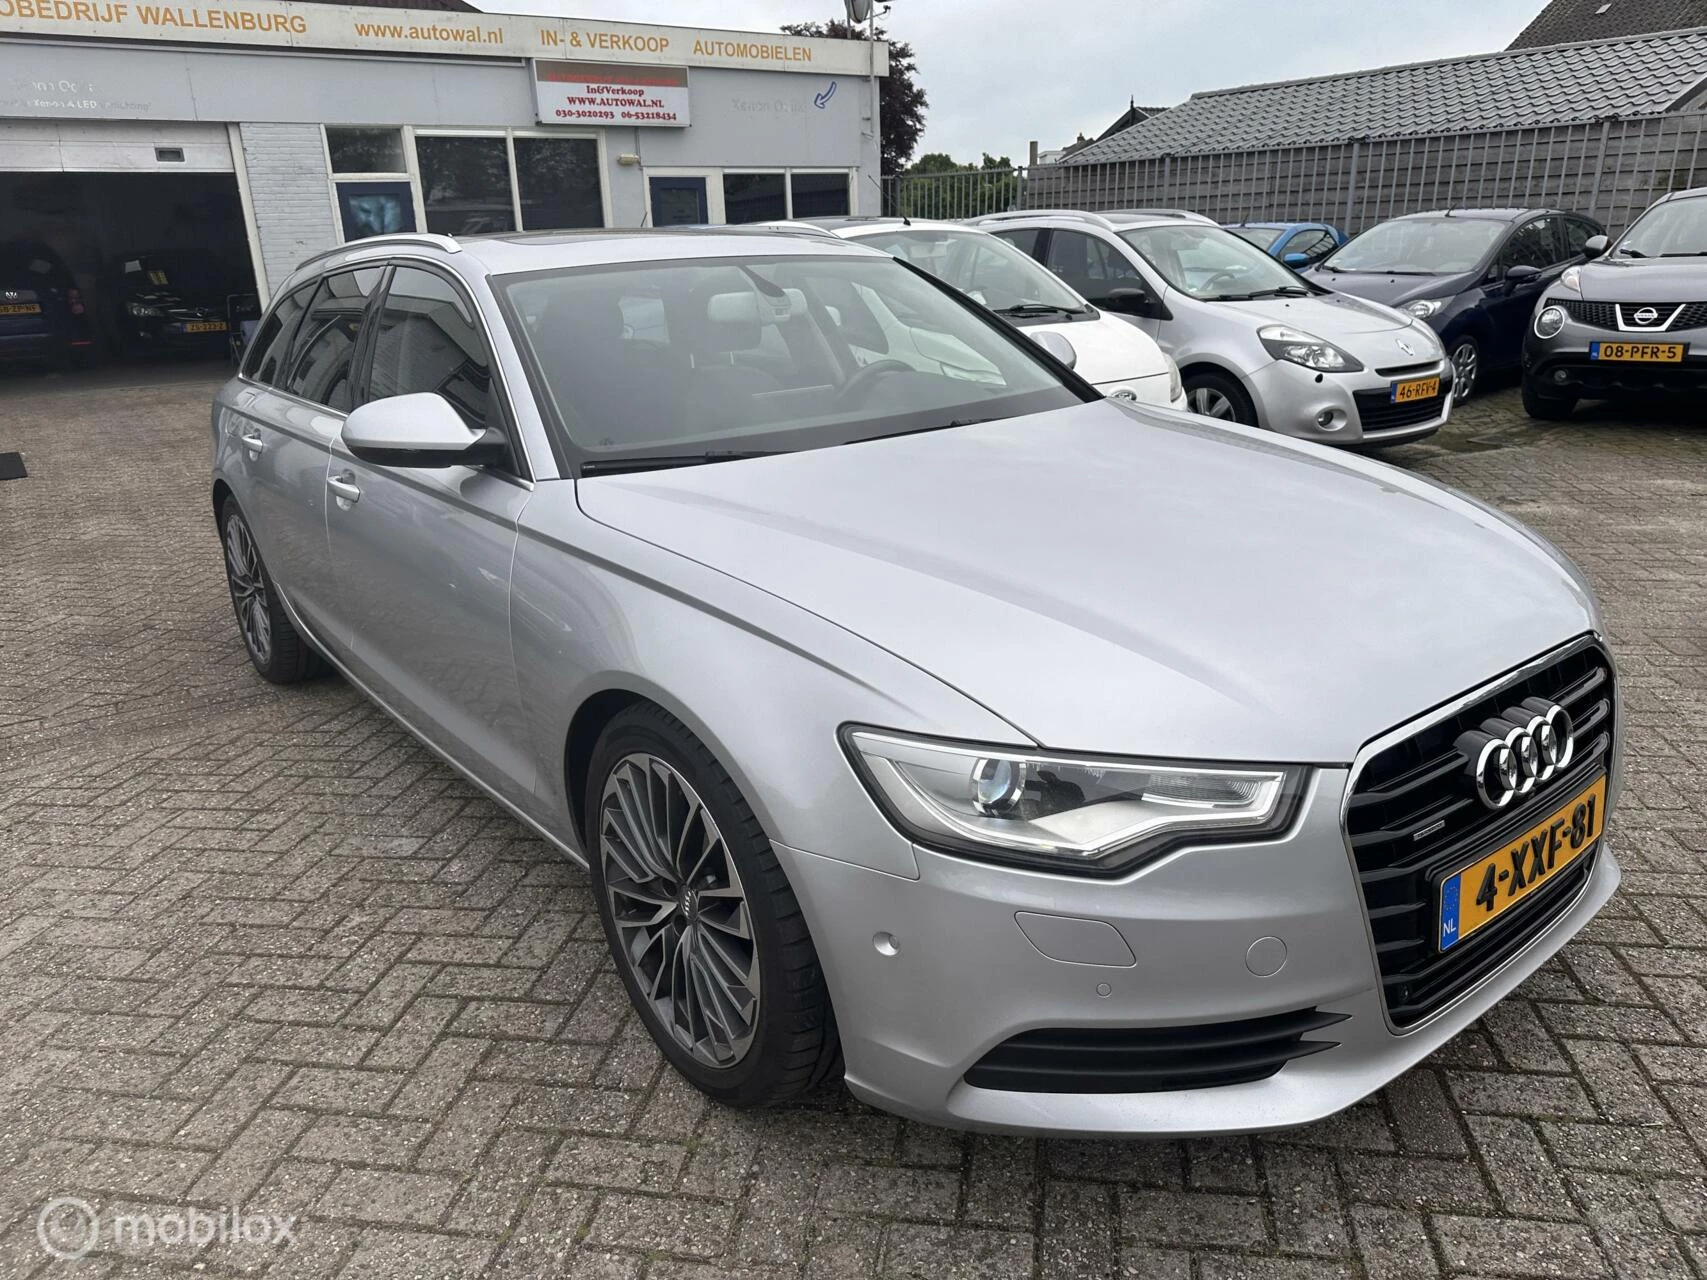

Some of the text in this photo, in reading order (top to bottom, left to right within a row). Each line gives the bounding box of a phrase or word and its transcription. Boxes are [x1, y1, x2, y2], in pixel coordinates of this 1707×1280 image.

[136, 5, 307, 33] WALLENBURG
[354, 23, 504, 44] www.autowal.nl
[540, 29, 669, 53] IN- & VERKOOP
[693, 40, 812, 62] AUTOMOBIELEN
[567, 96, 664, 108] WWW.AUTOWAL.NL
[555, 109, 677, 121] 030-3020293 06-53218434
[1603, 345, 1677, 359] 08-PFR-5
[1400, 381, 1437, 399] 46-RFV-4
[1476, 794, 1596, 911] 4-XXF-81
[1443, 918, 1456, 937] NL
